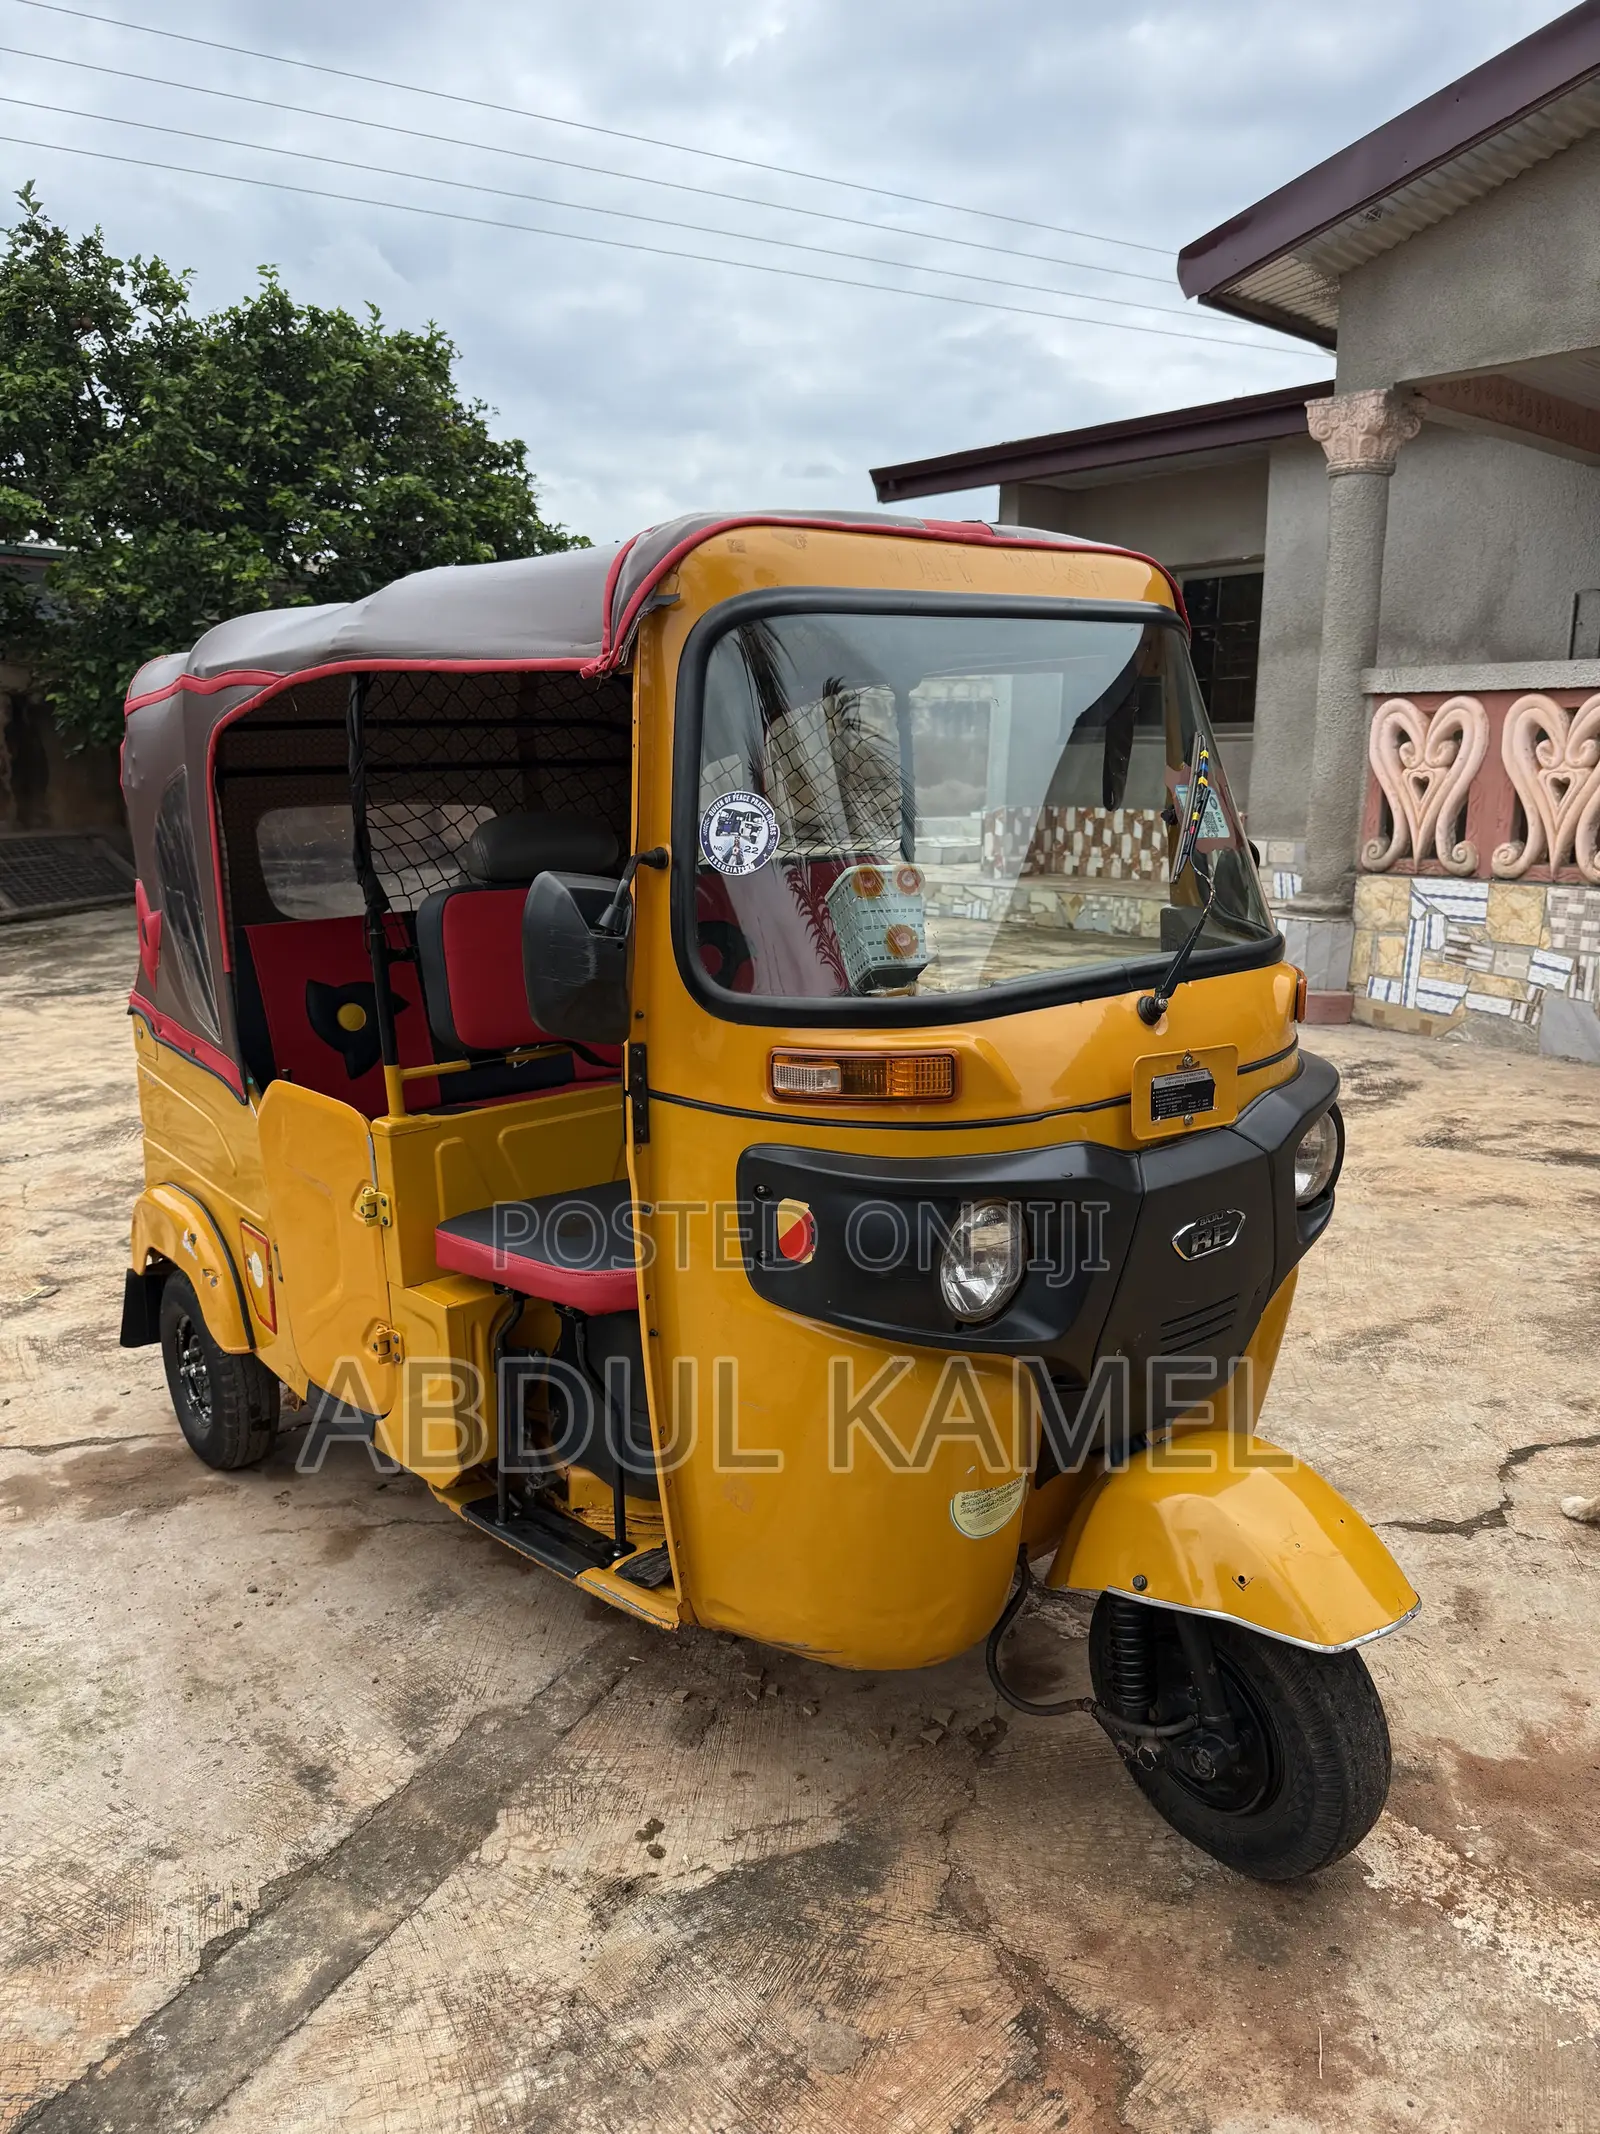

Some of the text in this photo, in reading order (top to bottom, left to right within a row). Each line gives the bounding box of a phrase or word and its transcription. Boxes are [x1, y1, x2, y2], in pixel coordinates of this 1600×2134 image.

[708, 799, 725, 817] QUEEN
[725, 796, 731, 804] OF
[732, 793, 750, 802] PEACE
[750, 797, 769, 815] PRAGIA
[743, 845, 759, 854] 22
[1199, 1212, 1224, 1226] BAJAJ
[1190, 1221, 1231, 1254] RE
